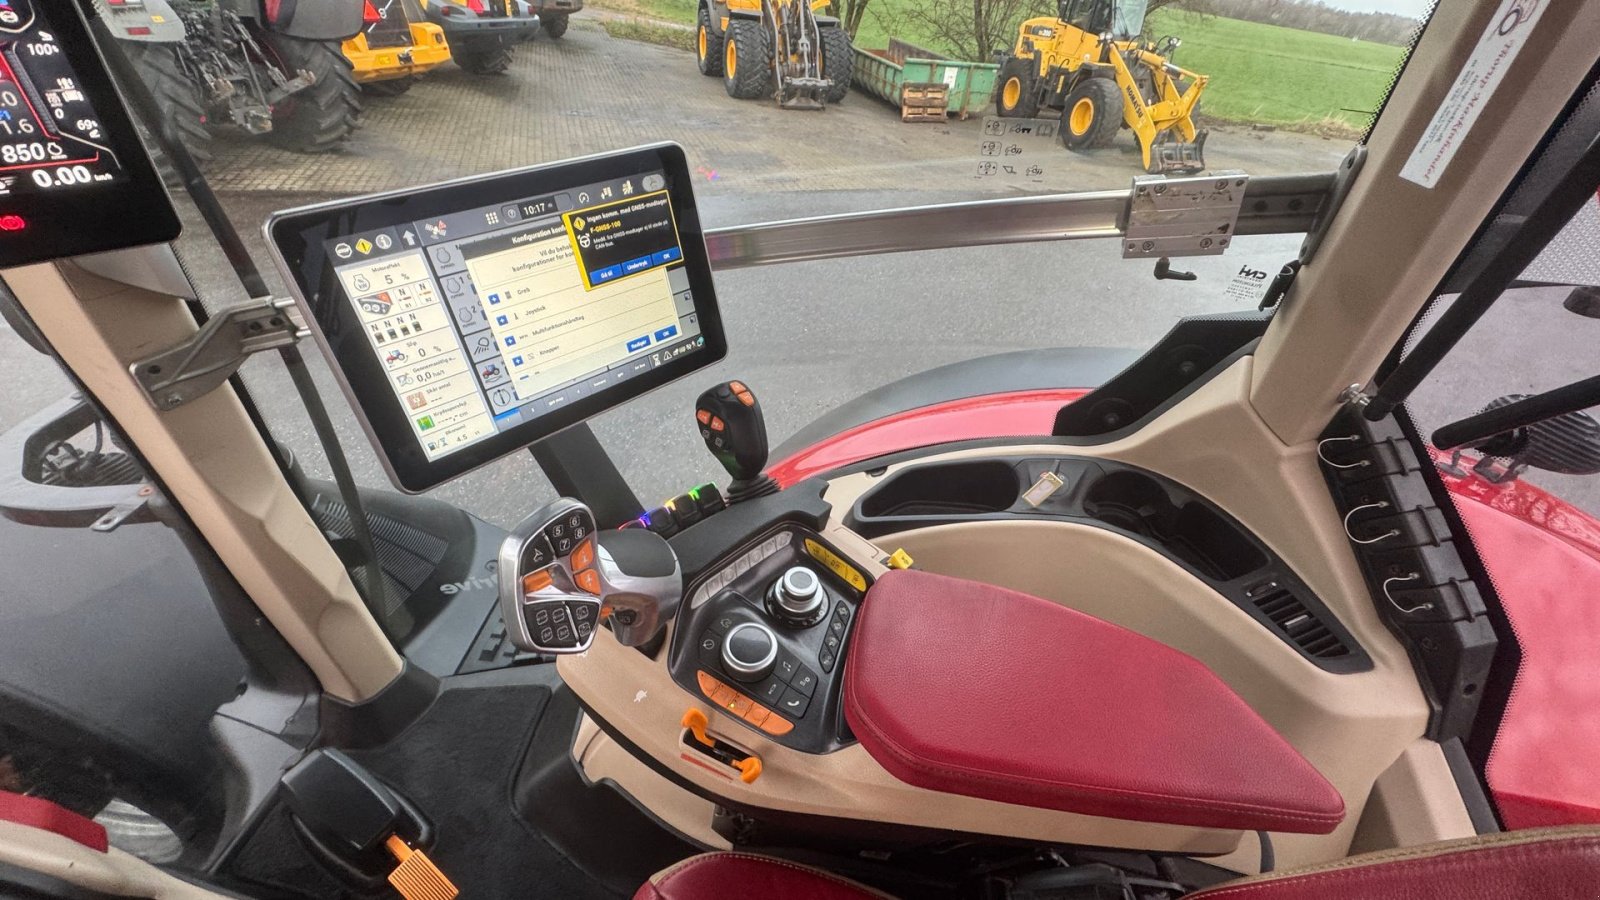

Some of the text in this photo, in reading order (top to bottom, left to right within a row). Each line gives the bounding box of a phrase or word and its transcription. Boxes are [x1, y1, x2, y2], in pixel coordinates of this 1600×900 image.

[1126, 84, 1144, 119] KOMATSU
[54, 108, 65, 119] 0
[1, 142, 46, 163] 850
[32, 165, 92, 188] 0.00
[523, 202, 546, 216] 10:17
[511, 226, 551, 245] Konfiguration
[384, 274, 394, 285] 5
[398, 288, 406, 296] N
[419, 283, 427, 291] N
[525, 305, 546, 316] Joystick
[371, 323, 379, 332] N
[409, 312, 417, 320] N
[418, 348, 426, 358] 0
[416, 371, 432, 382] 0,0
